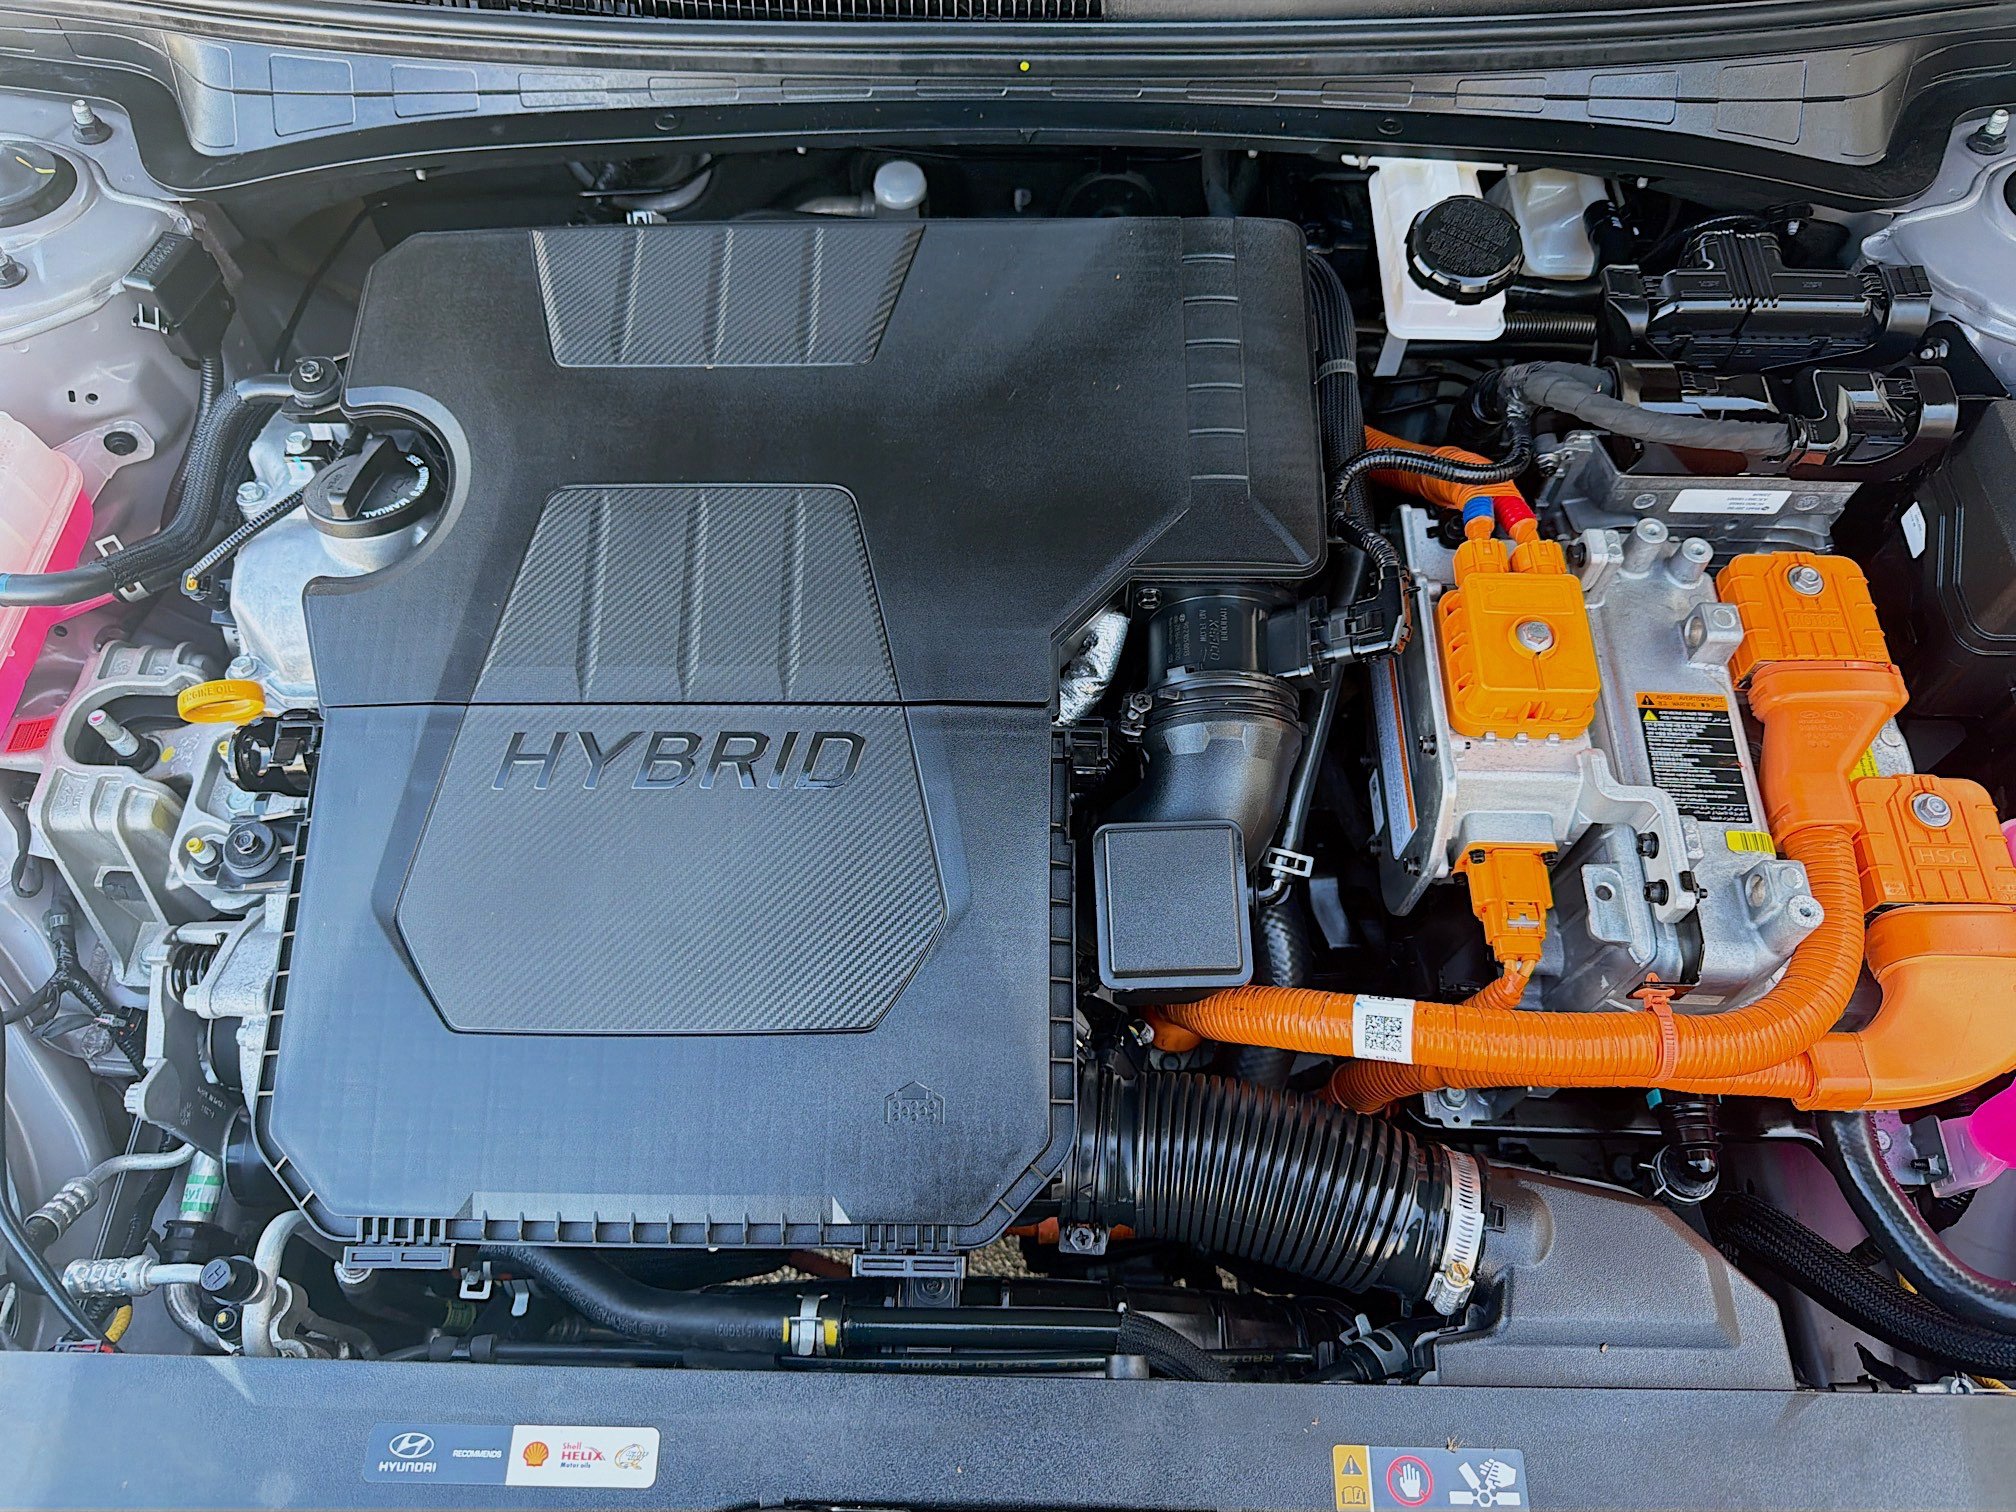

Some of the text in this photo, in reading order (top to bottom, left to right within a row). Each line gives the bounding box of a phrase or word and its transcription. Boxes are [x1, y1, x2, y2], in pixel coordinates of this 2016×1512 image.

[361, 497, 410, 518] MANUAL
[181, 684, 235, 704] ENGINE OIL
[491, 731, 866, 790] HYBRID
[1919, 848, 1968, 864] HSG
[562, 1441, 582, 1450] Shell
[452, 1449, 502, 1459] RECOMMENDS
[561, 1451, 603, 1461] HELIX
[378, 1461, 437, 1473] HYUNDAI
